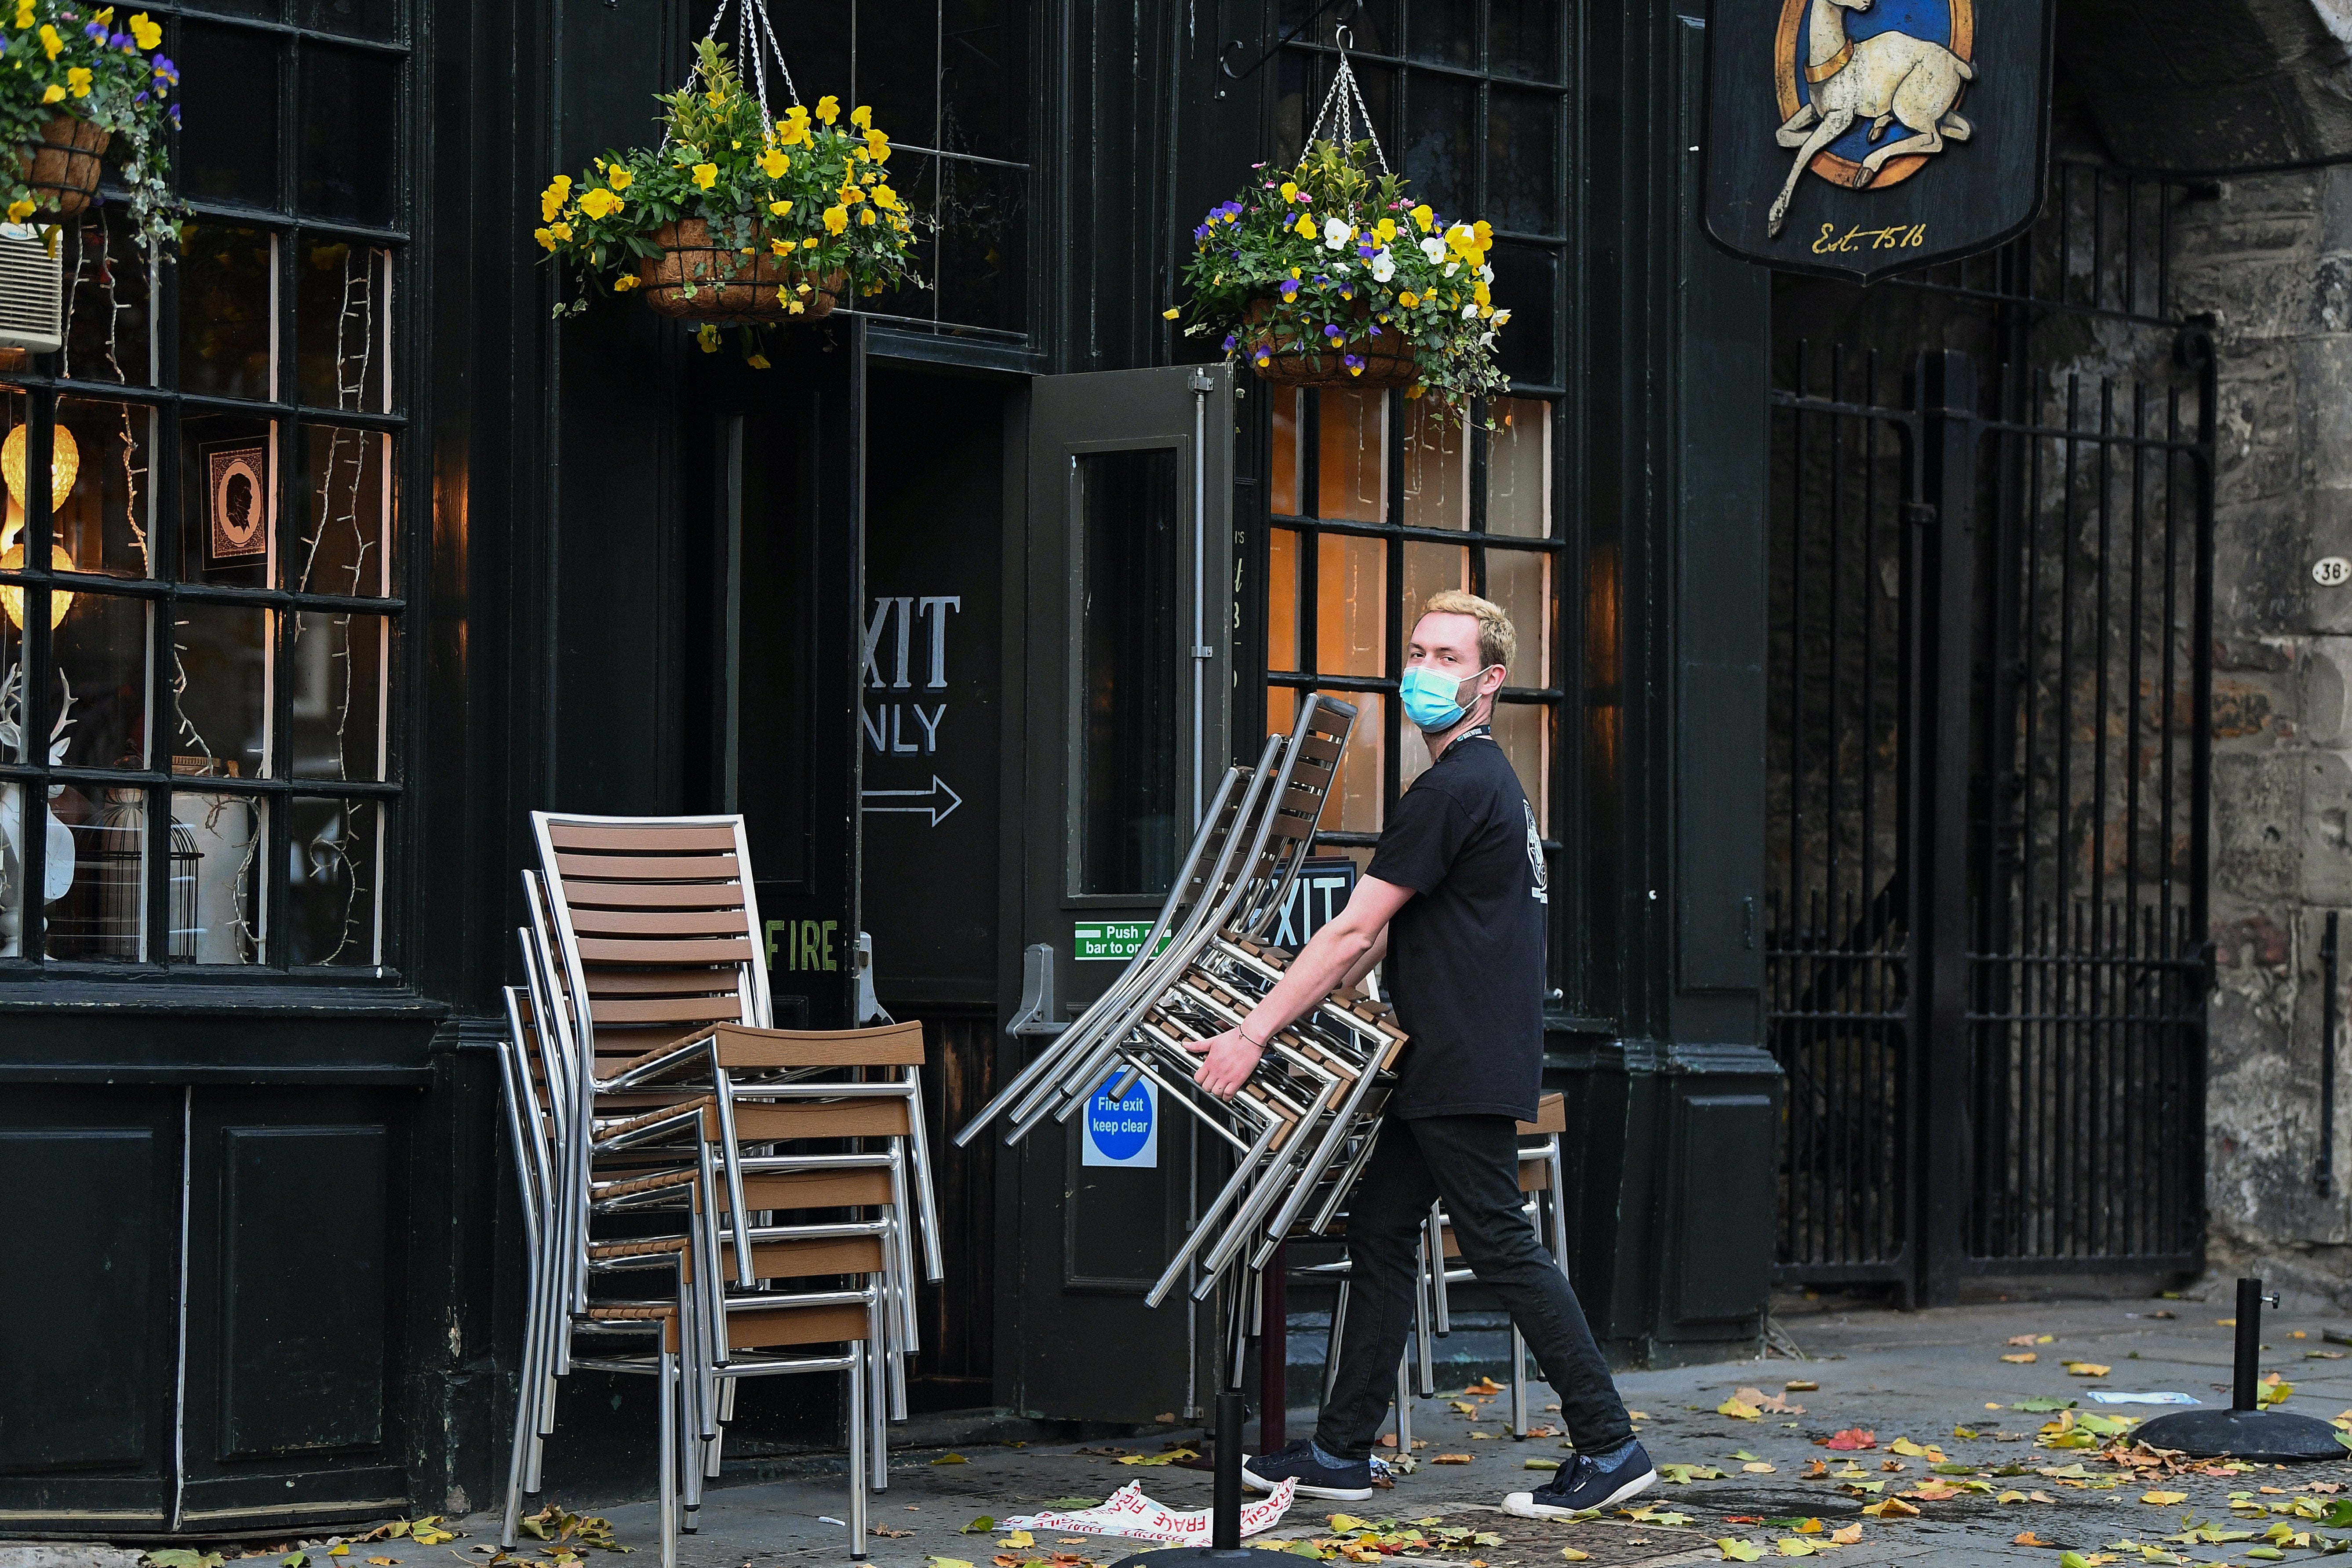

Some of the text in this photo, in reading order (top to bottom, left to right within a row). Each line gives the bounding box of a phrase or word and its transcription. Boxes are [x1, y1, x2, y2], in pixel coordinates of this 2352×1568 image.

[1812, 223, 1926, 254] Est. 1516
[2321, 563, 2341, 581] 38
[863, 596, 961, 688] XIT
[863, 704, 947, 751] NLY
[1107, 925, 1138, 939] Push
[765, 920, 837, 971] FIRE
[1086, 941, 1107, 953] bar
[1110, 942, 1123, 953] to
[1098, 1097, 1143, 1111] Fire exit
[1093, 1118, 1148, 1135] keep clear
